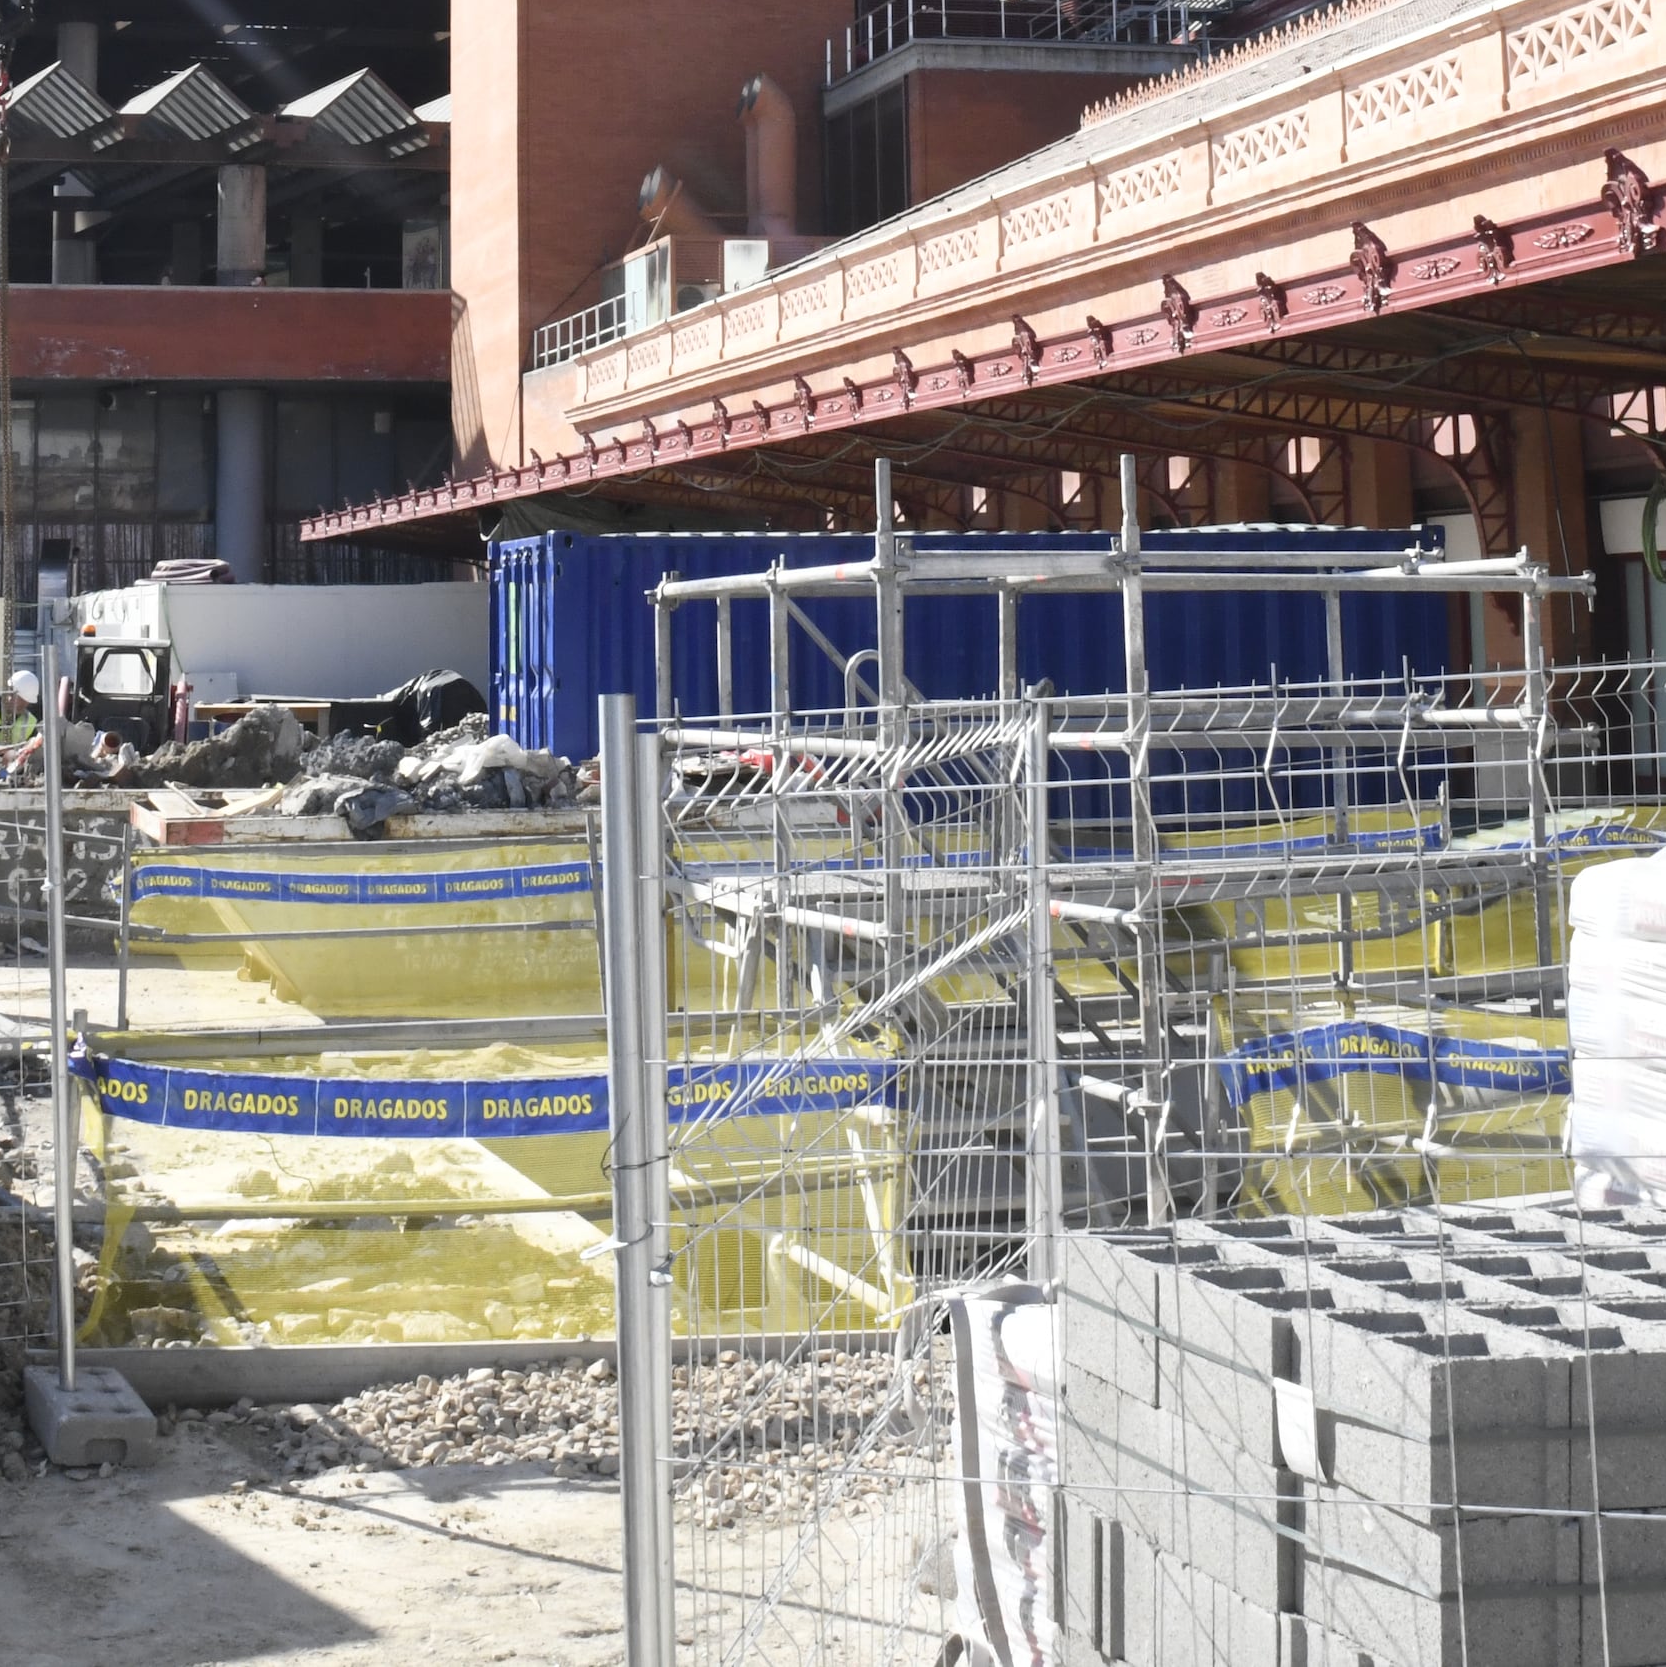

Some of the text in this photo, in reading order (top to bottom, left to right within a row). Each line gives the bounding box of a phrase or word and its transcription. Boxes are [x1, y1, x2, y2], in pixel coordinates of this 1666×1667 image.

[211, 879, 271, 893] DRAGADOS
[289, 883, 349, 896] DRAGADOS
[367, 883, 427, 896] DRAGADOS
[445, 878, 504, 893] DRAGADOS
[521, 872, 580, 887] DRAGADOS
[1340, 1036, 1421, 1060] DRAGADOS
[1449, 1052, 1539, 1077] DRAGADOS
[96, 1077, 148, 1104] ADOS
[184, 1089, 298, 1117] DRAGADOS
[334, 1098, 448, 1121] DRAGADOS
[483, 1094, 592, 1119] DRAGADOS
[668, 1080, 732, 1106] GADOS
[764, 1073, 868, 1098] DRAGADOS
